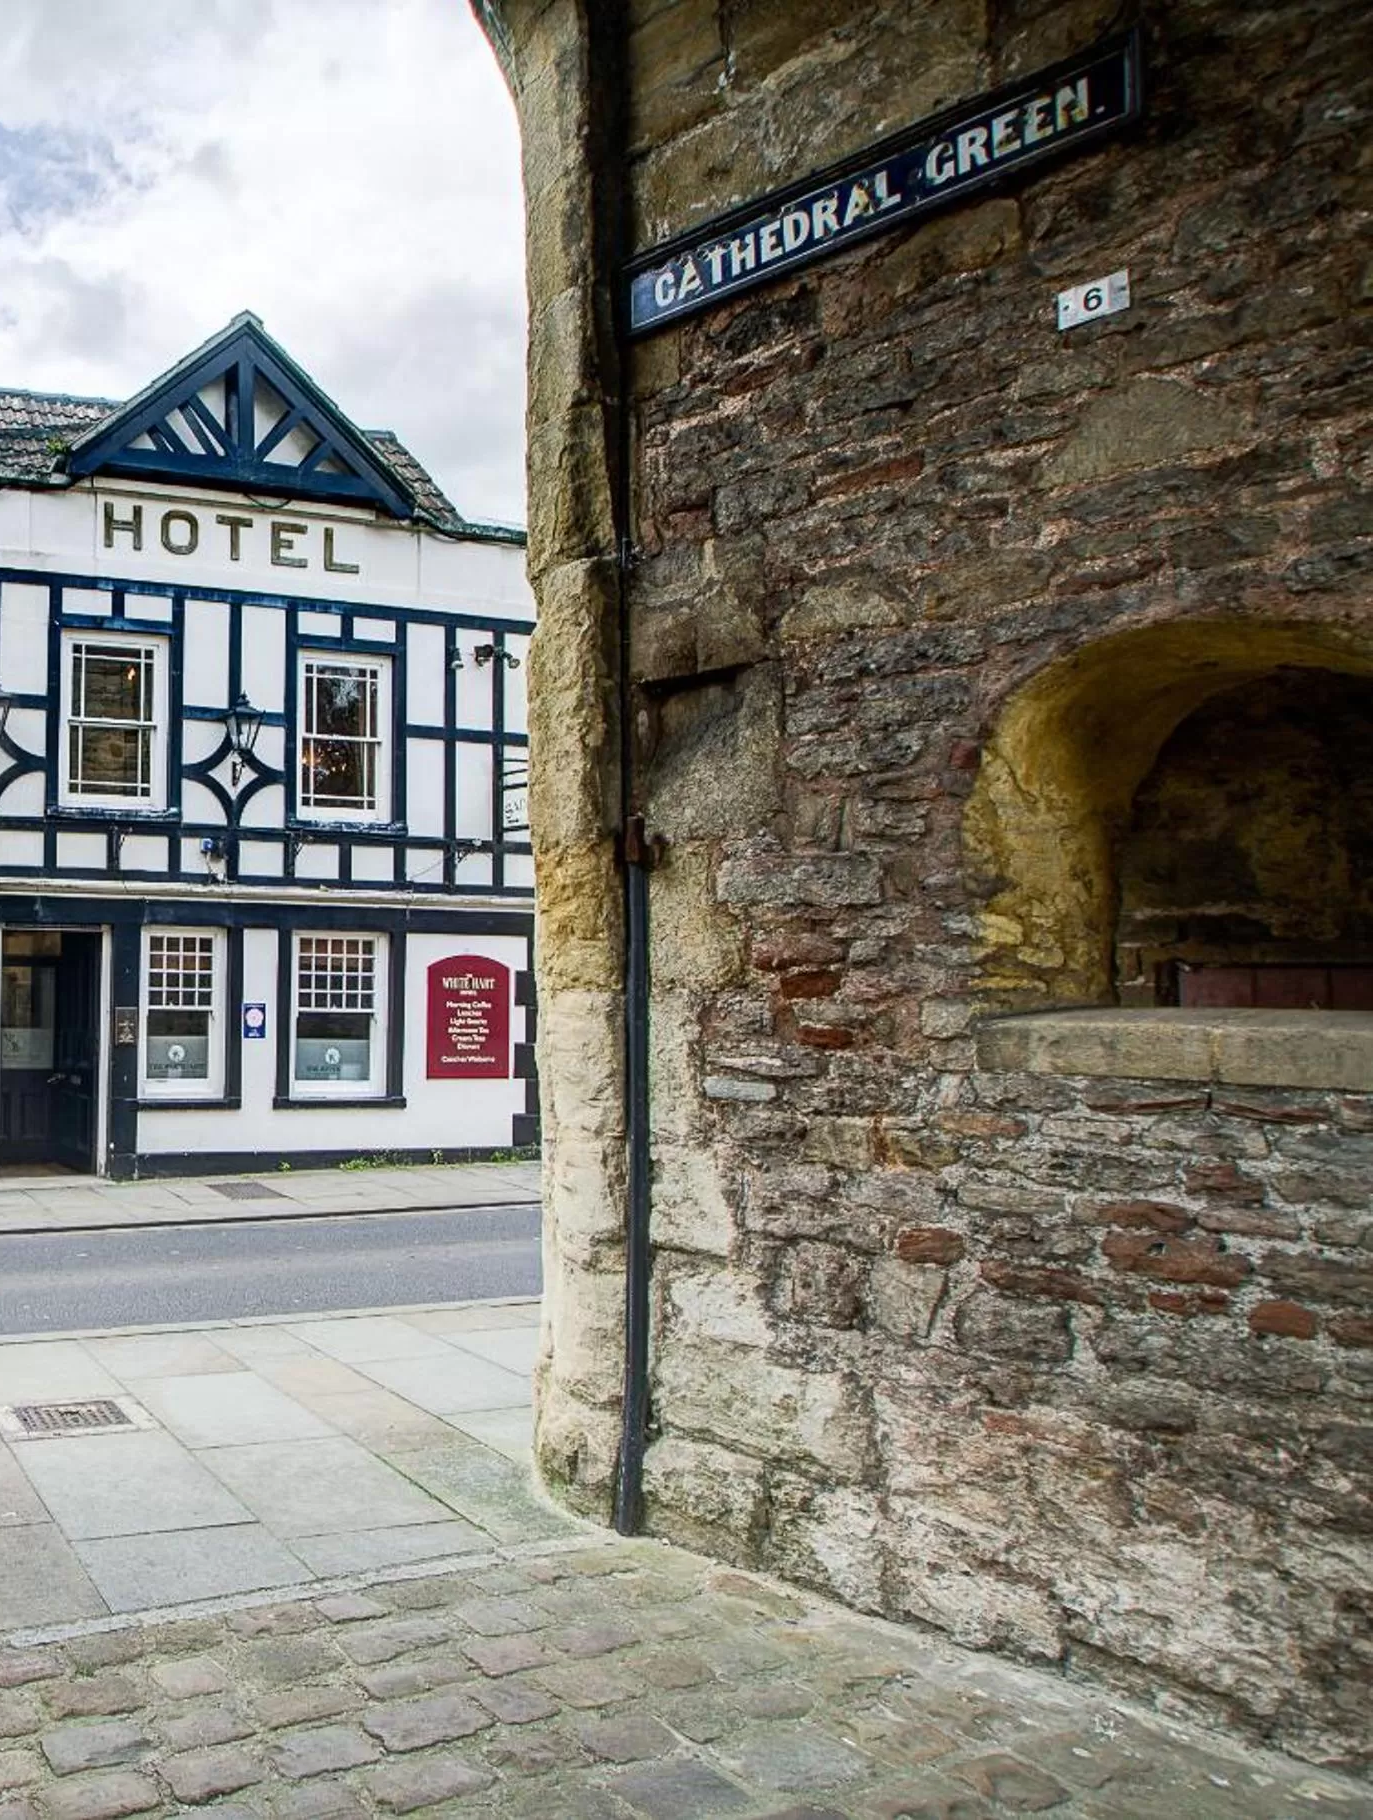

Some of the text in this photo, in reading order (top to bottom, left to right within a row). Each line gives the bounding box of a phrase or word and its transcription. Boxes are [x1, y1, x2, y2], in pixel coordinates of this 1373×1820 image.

[653, 171, 903, 309] CATHEDRAL
[1083, 284, 1104, 312] 6
[102, 501, 361, 574] HOTEL
